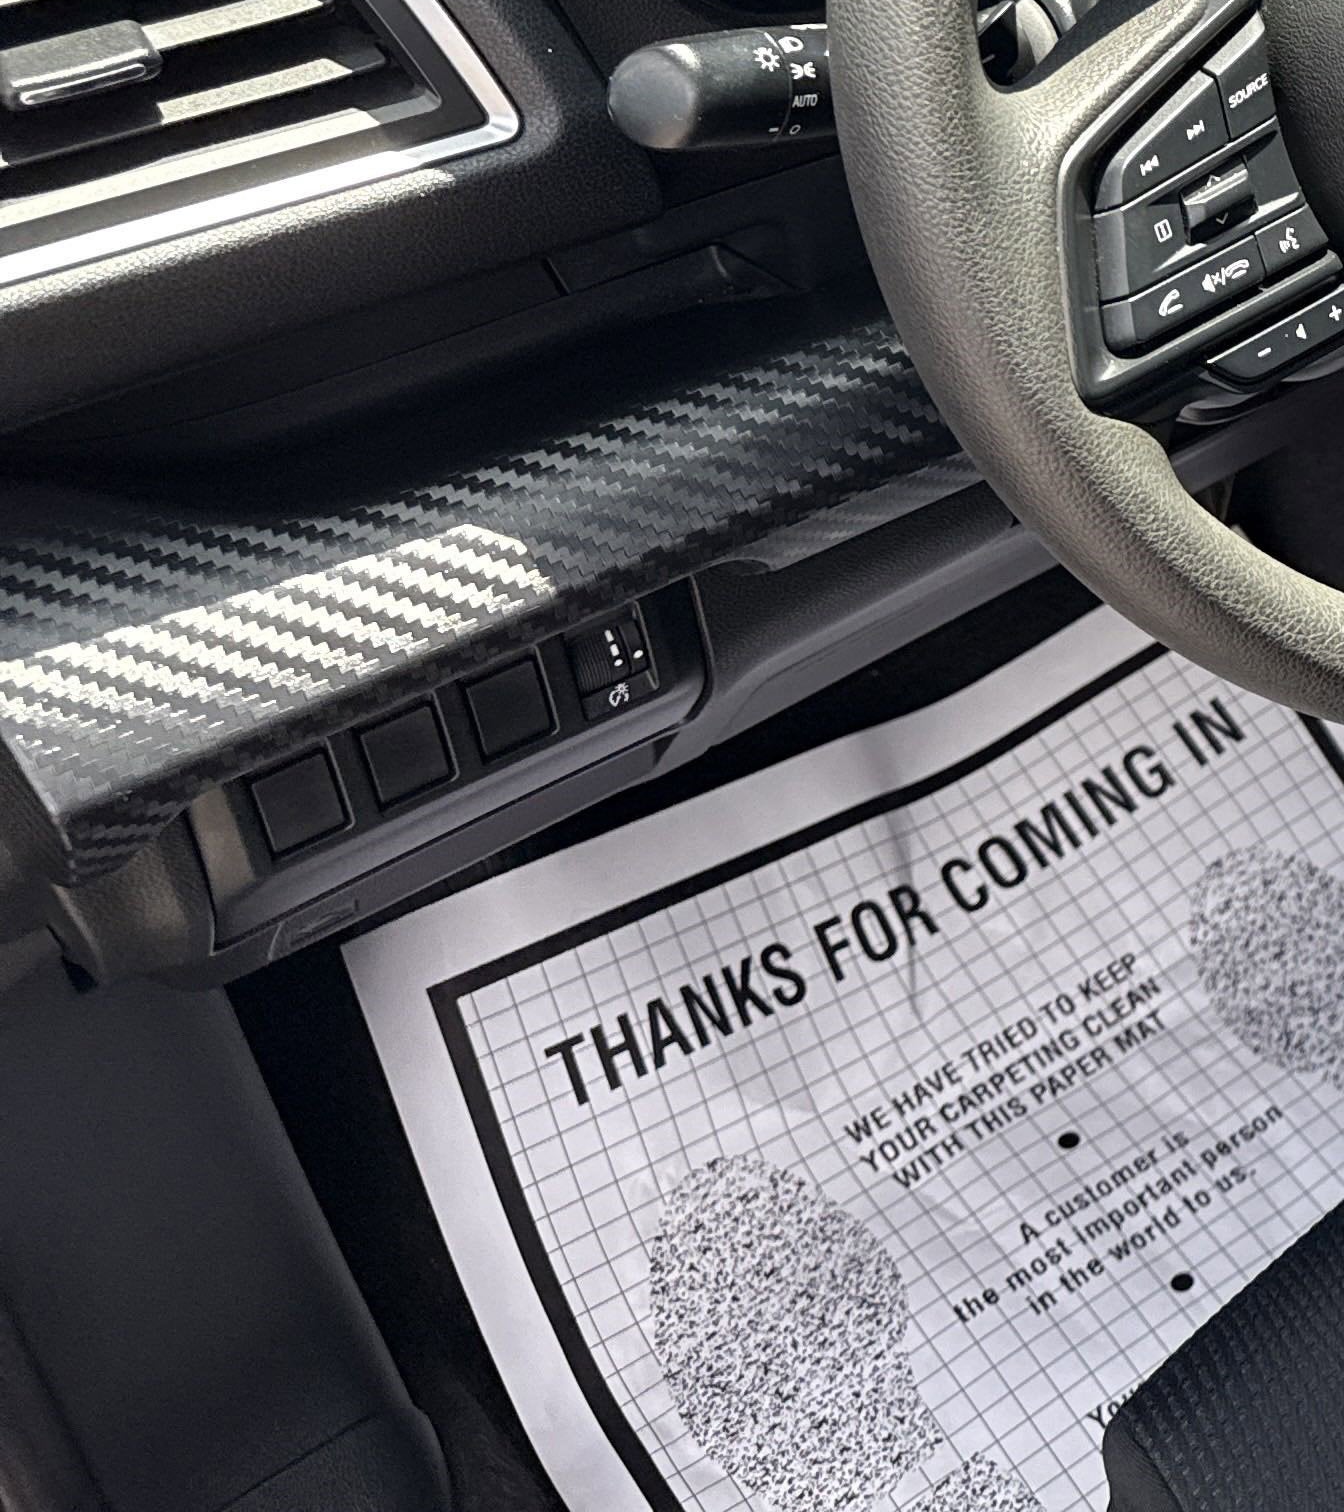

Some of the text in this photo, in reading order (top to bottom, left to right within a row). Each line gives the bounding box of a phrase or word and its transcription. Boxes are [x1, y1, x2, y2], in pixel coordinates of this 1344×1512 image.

[792, 93, 818, 108] AUTO
[1228, 73, 1269, 109] SOURCE
[545, 698, 1248, 1108] THANKS FOR COMING IN
[844, 952, 1137, 1145] WE HAVE TRIED TO KEEP
[859, 977, 1162, 1174] YOUR CARPETING CLEAN
[892, 1010, 1167, 1192] WITH THIS PAPER MAT
[953, 1103, 1284, 1323] the most important person
[1018, 1130, 1190, 1245] A customer is
[1028, 1164, 1257, 1316] in the world to us.
